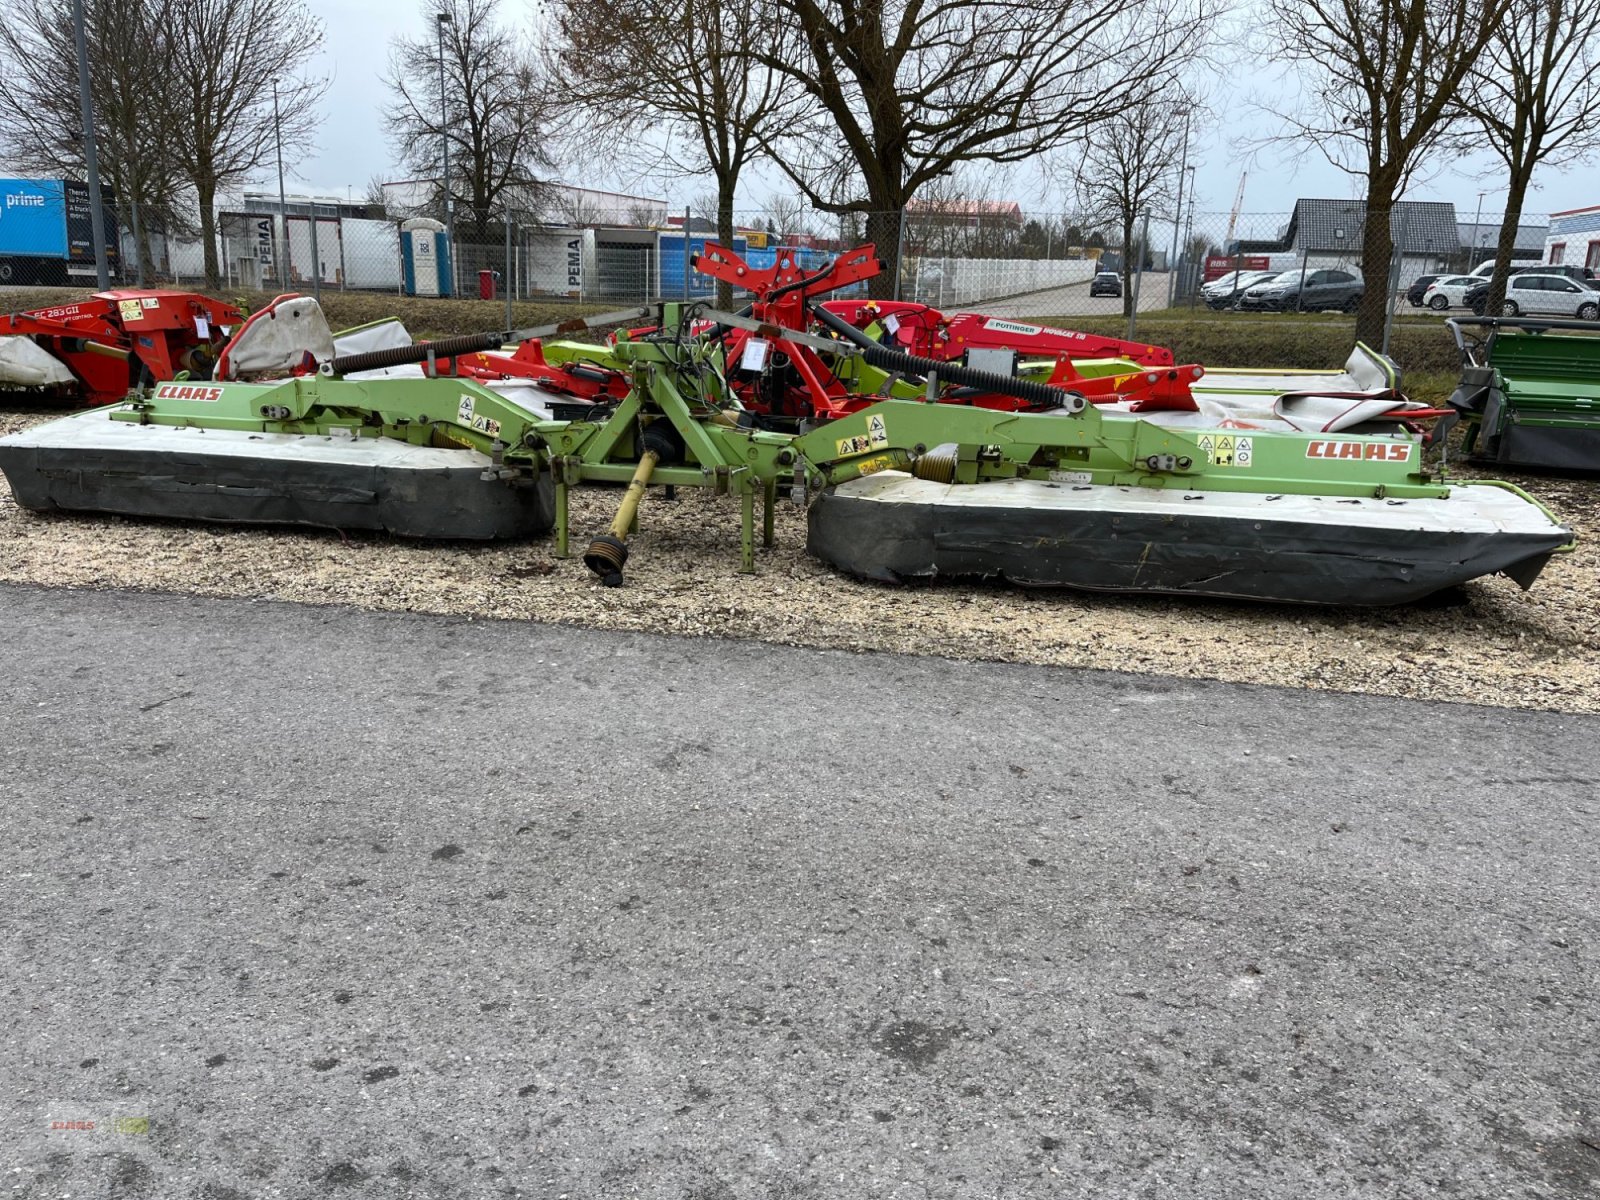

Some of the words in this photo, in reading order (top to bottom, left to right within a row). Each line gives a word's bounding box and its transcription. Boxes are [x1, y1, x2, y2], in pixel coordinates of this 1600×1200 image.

[6, 191, 45, 209] prime
[257, 220, 272, 265] PEMA
[567, 239, 580, 286] PEMA
[48, 308, 65, 318] 283
[157, 385, 222, 401] CLAAS
[1306, 441, 1409, 461] CLAAS
